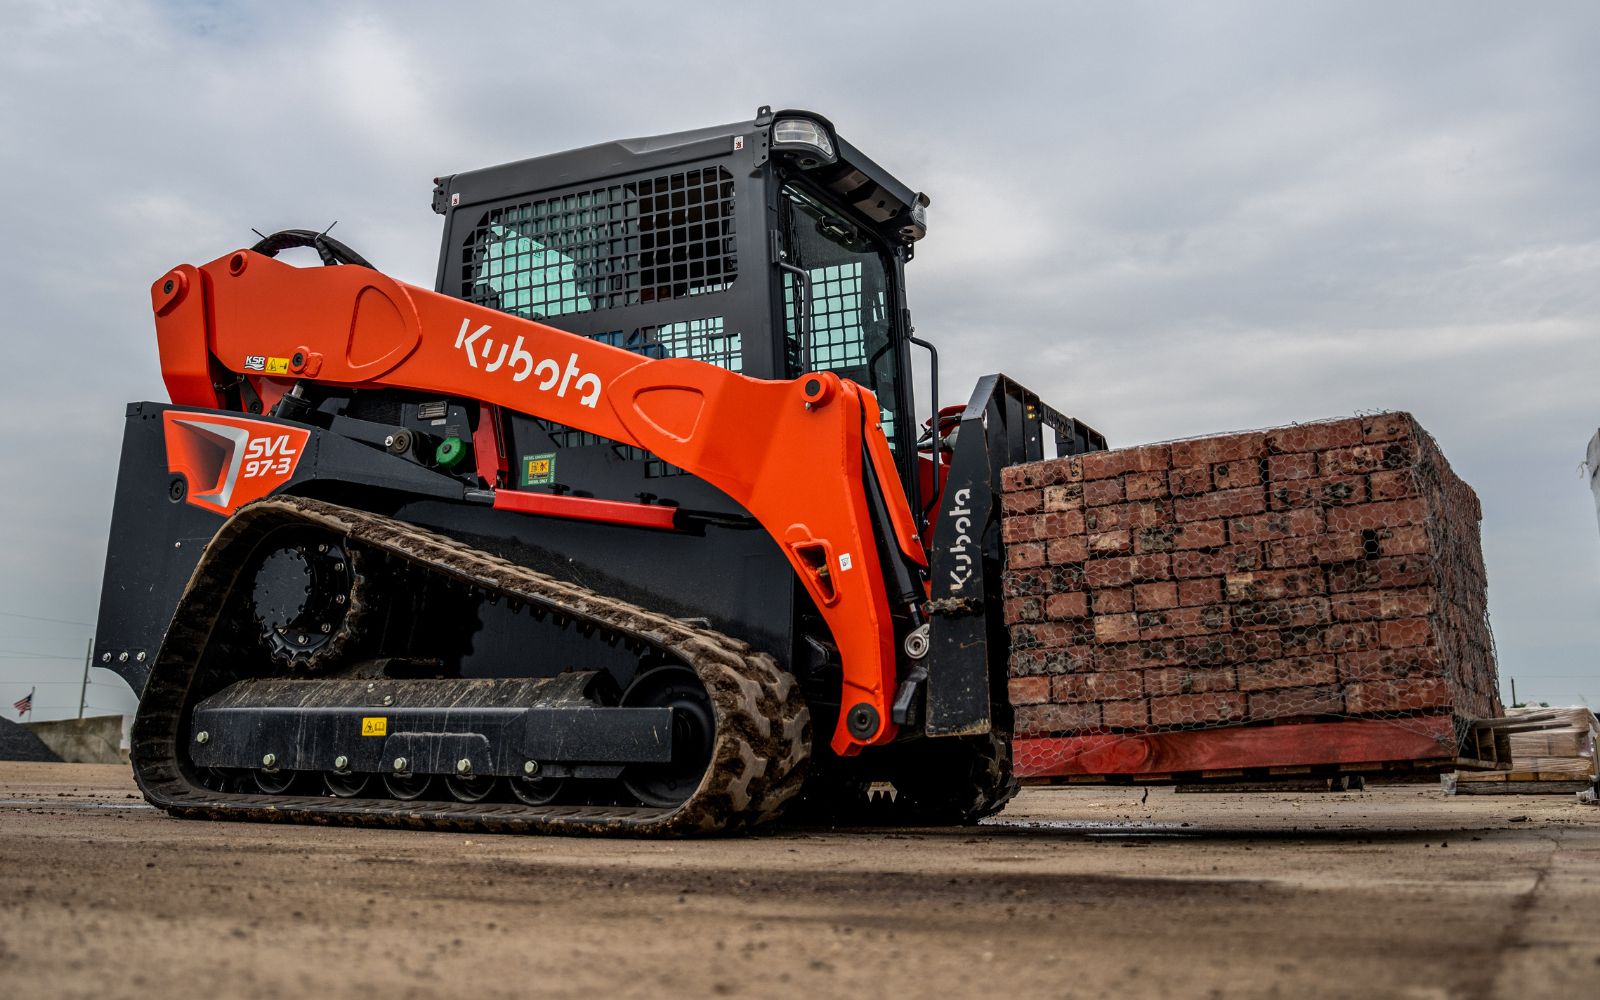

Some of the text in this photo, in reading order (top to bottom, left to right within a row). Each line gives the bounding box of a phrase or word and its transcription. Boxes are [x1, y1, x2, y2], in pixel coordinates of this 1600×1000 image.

[245, 355, 266, 365] KSR
[454, 317, 602, 409] Kubota
[244, 434, 297, 459] SVL
[243, 457, 292, 478] 97-3
[948, 488, 972, 591] Kubota
